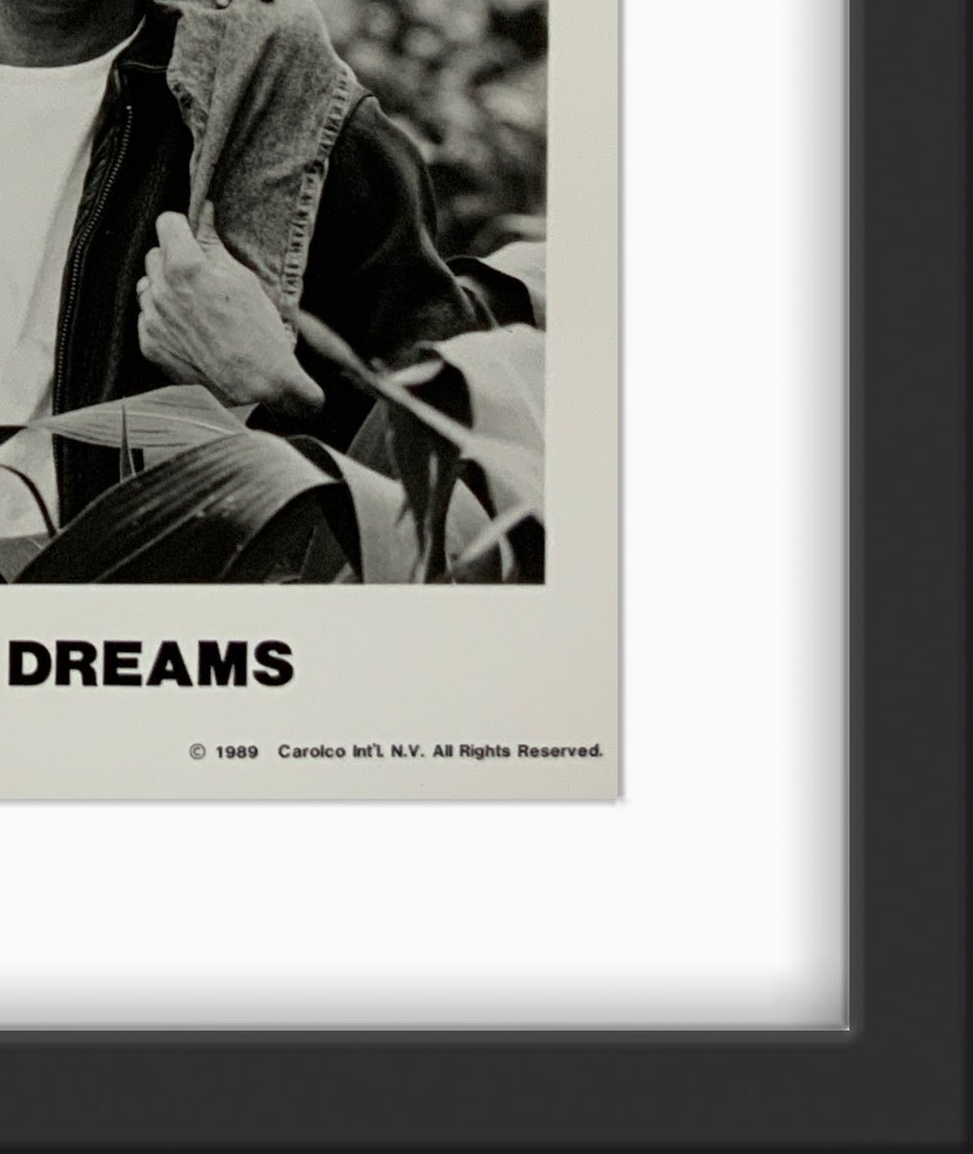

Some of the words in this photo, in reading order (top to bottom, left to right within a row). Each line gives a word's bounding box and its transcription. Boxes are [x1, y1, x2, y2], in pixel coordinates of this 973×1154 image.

[8, 640, 294, 688] DREAMS
[216, 745, 259, 759] 1989
[277, 744, 346, 759] Carolco
[390, 744, 425, 758] N.V.
[432, 744, 453, 758] All
[459, 744, 511, 761] Rights
[517, 743, 604, 758] Reserved.
